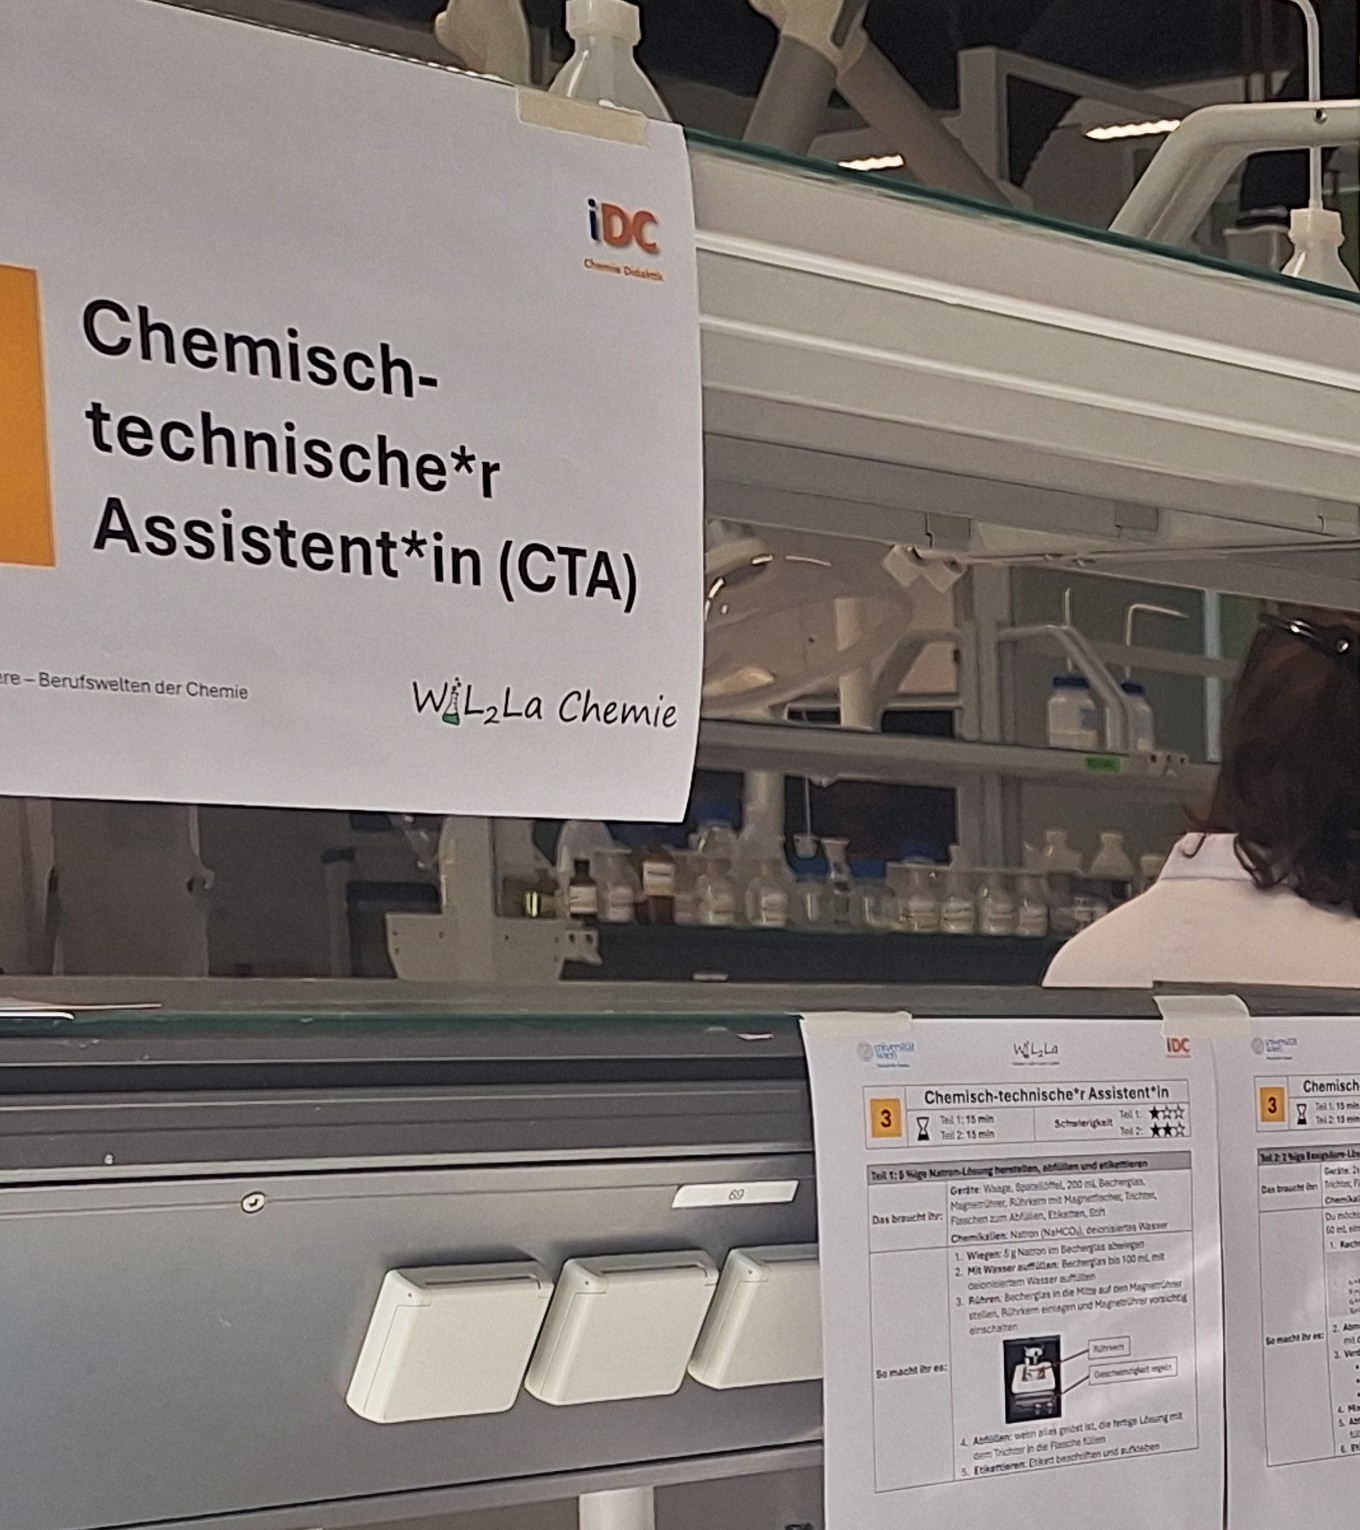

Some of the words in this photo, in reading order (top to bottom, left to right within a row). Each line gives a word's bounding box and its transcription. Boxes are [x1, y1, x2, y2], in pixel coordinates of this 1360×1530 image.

[83, 299, 438, 398] Chemisch-
[499, 540, 638, 614] (CTA)
[39, 671, 151, 693] Berufswelten
[155, 680, 182, 695] der
[186, 681, 248, 700] Chemie
[558, 689, 677, 727] Chemie
[881, 1109, 891, 1127] 3
[1268, 1097, 1277, 1113] 3
